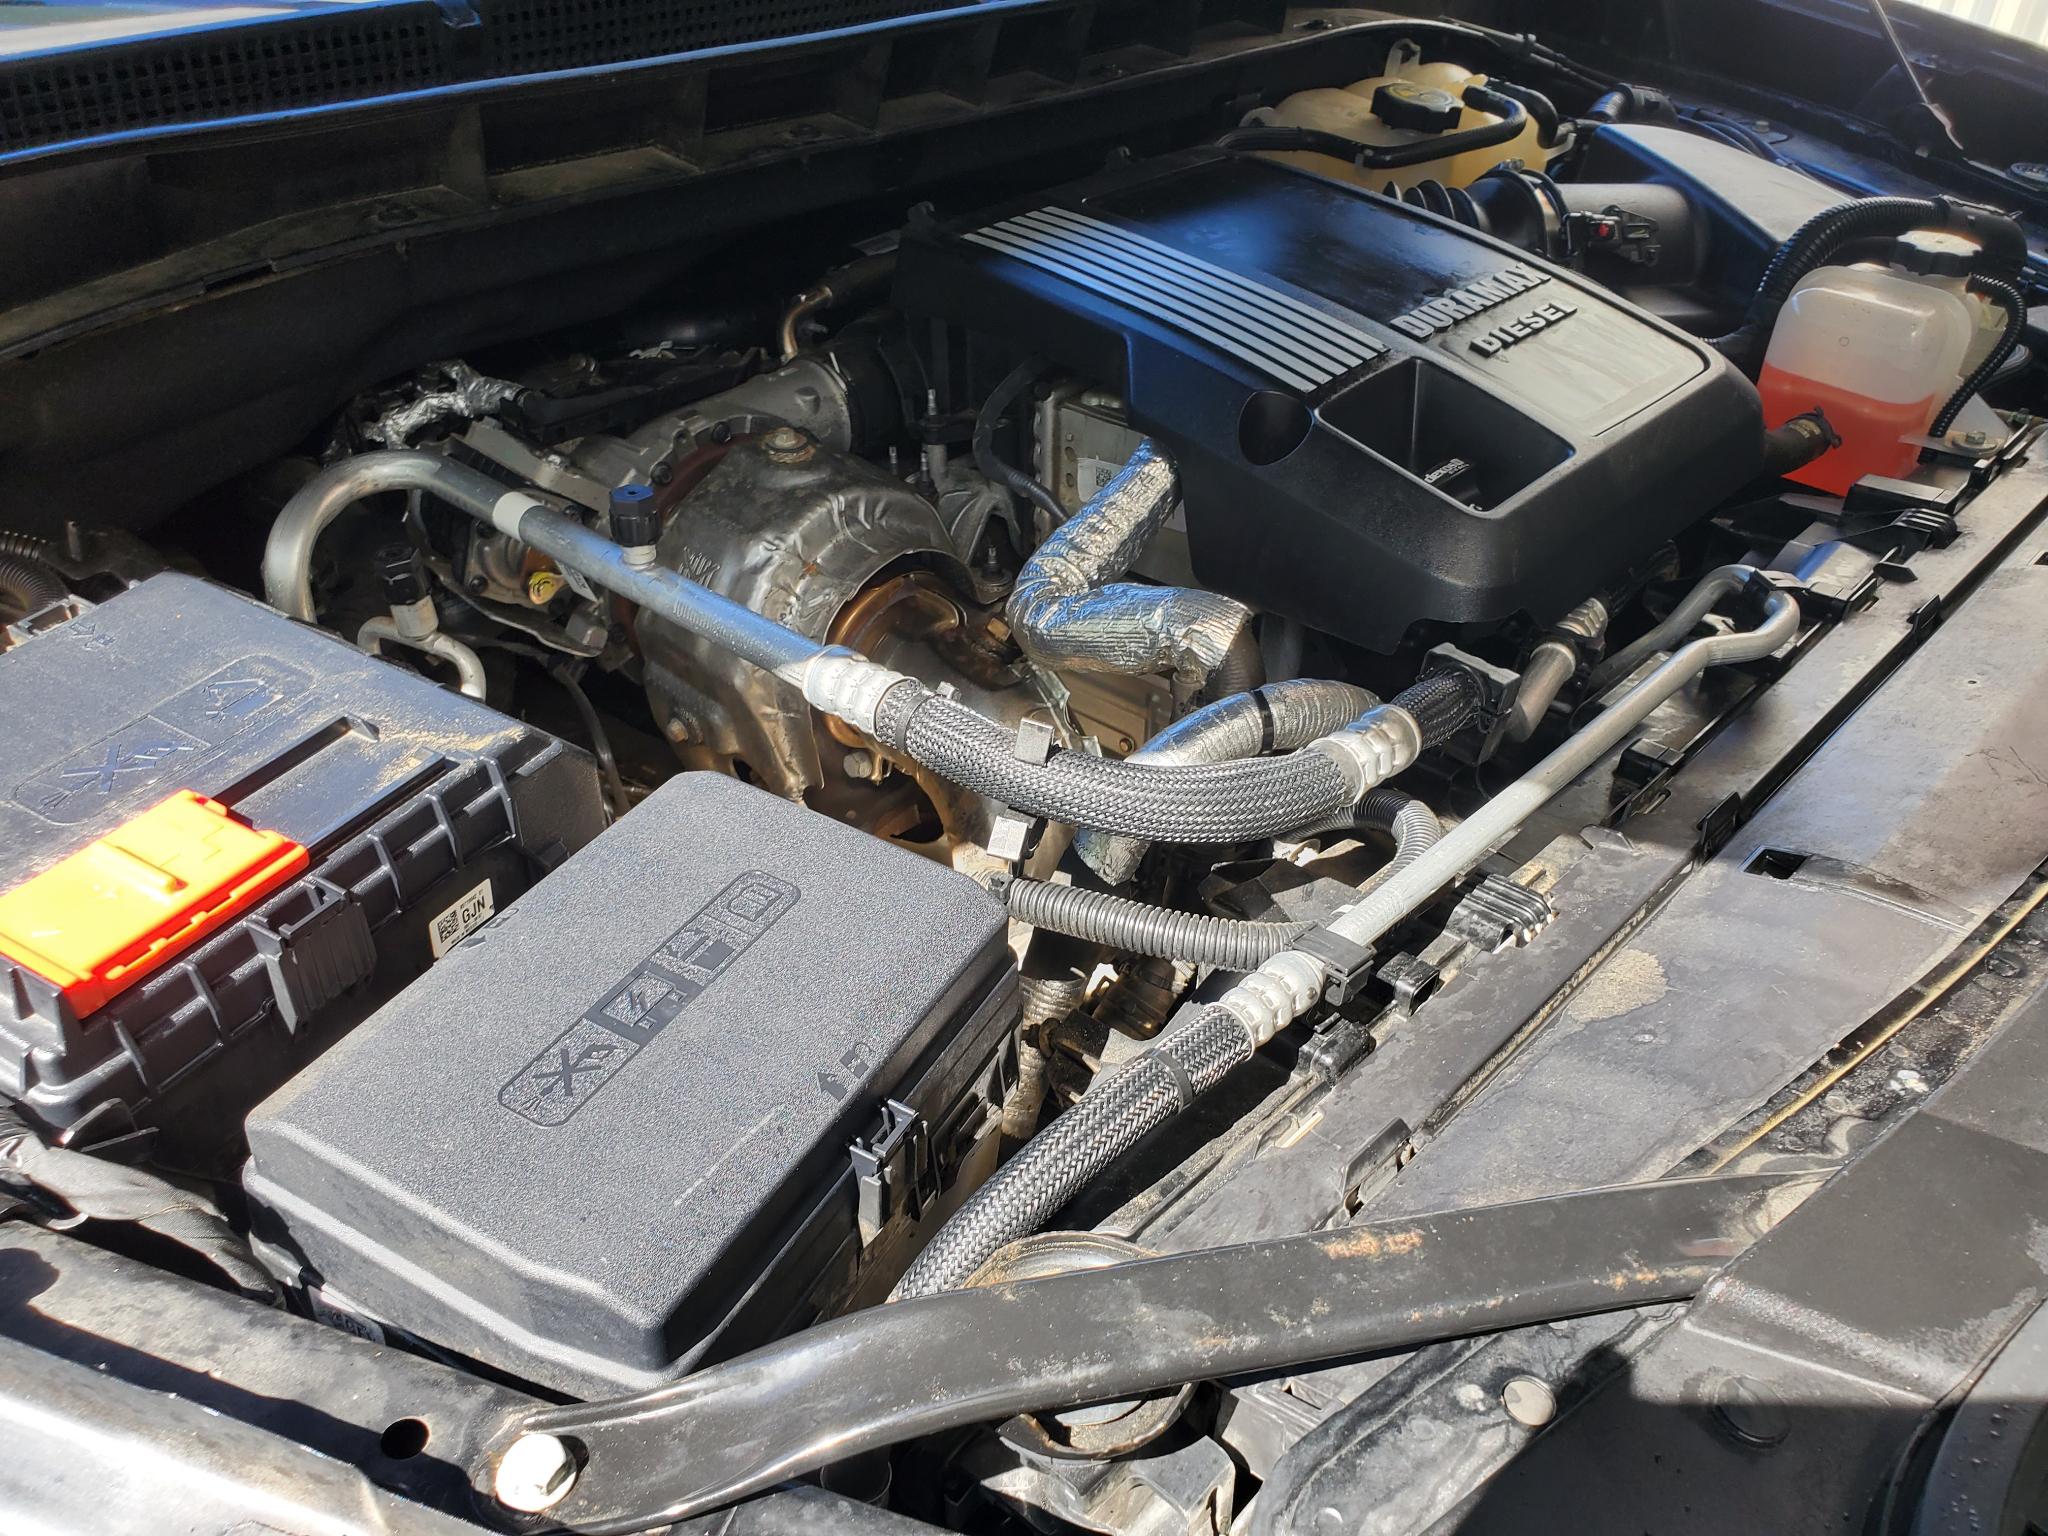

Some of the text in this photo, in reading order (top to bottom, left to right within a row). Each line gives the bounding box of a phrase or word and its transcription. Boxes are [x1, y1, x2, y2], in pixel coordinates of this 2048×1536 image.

[1389, 262, 1552, 340] DURAMAX
[1469, 300, 1578, 358] DIESEL
[462, 896, 486, 924] GJN
